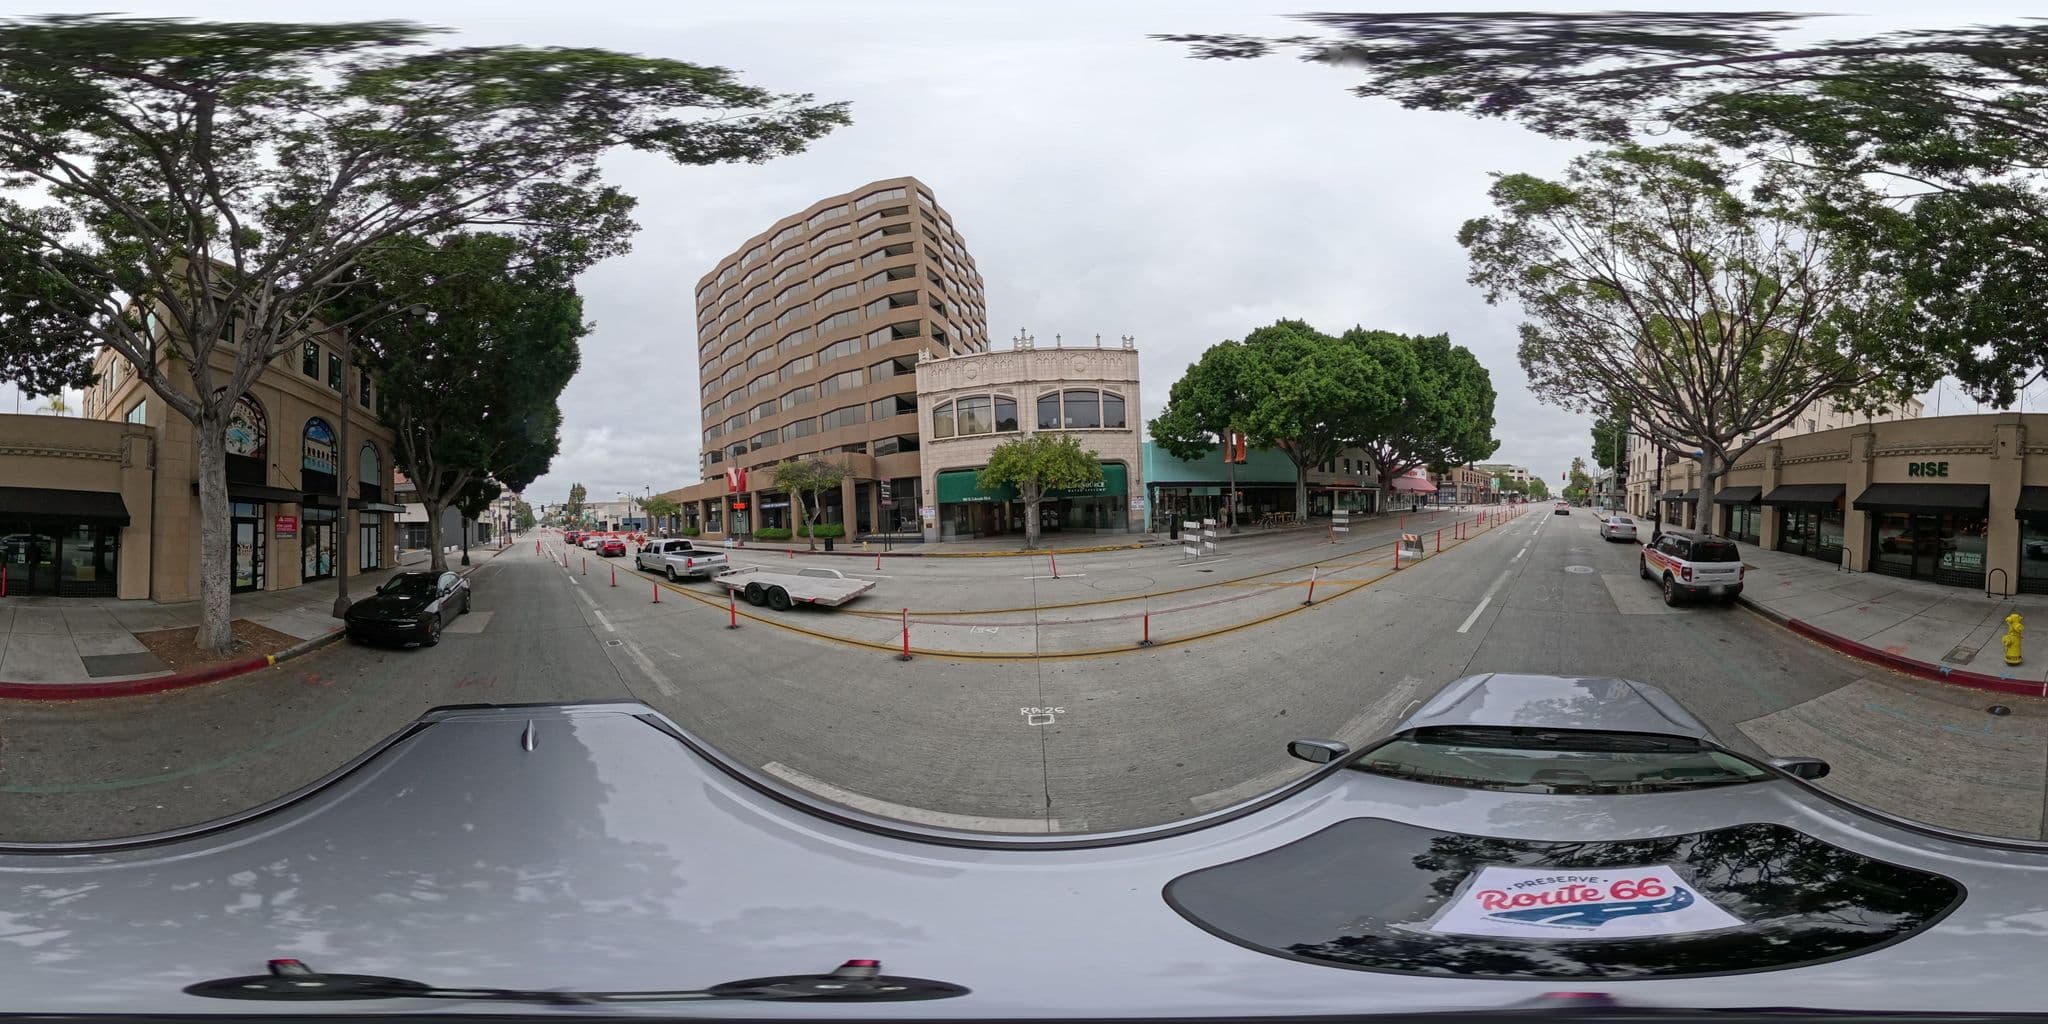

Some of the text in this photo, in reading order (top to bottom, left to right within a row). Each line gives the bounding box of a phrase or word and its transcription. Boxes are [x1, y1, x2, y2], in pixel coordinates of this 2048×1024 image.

[1909, 462, 1948, 477] RISE
[1515, 876, 1599, 890] PRESERVE
[1476, 877, 1667, 911] Route 66
